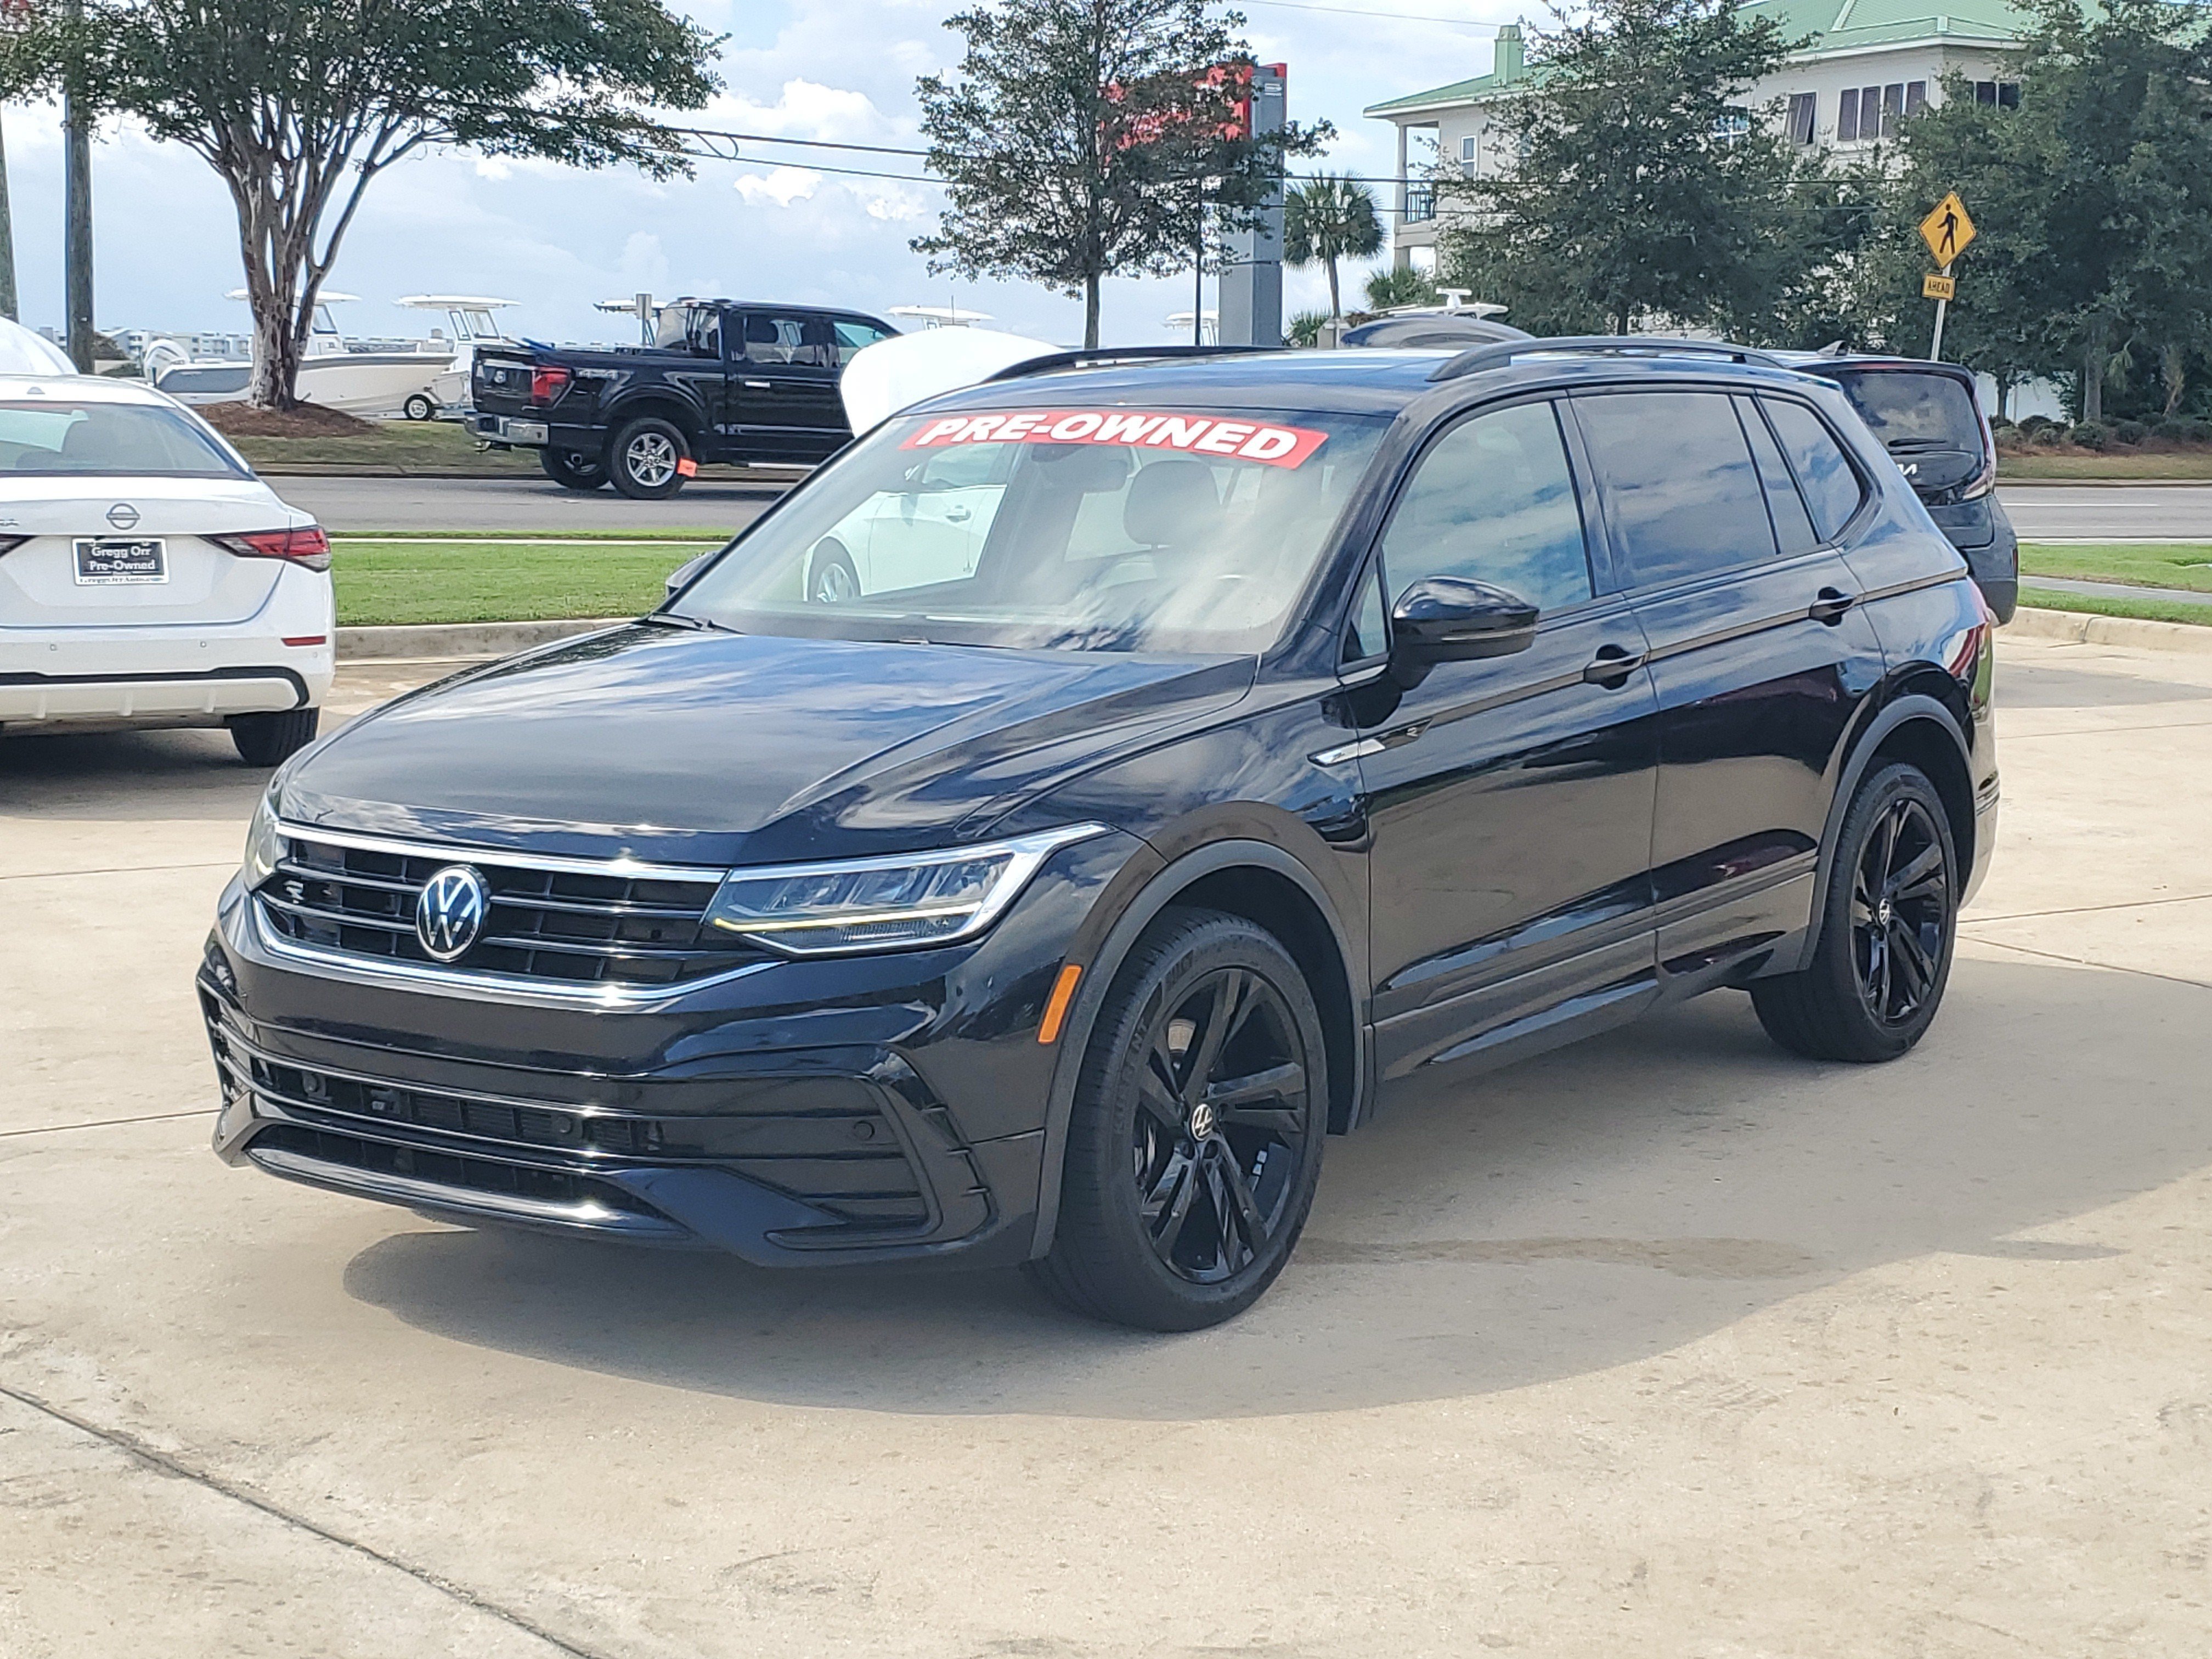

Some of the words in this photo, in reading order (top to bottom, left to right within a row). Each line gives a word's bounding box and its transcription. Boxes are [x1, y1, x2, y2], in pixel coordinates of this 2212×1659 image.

[1928, 280, 1950, 294] AHEAD
[916, 413, 1298, 460] PRE-OWNED
[91, 546, 128, 558] Gregg
[130, 546, 151, 556] Orr
[88, 560, 155, 570] Pre-Owned
